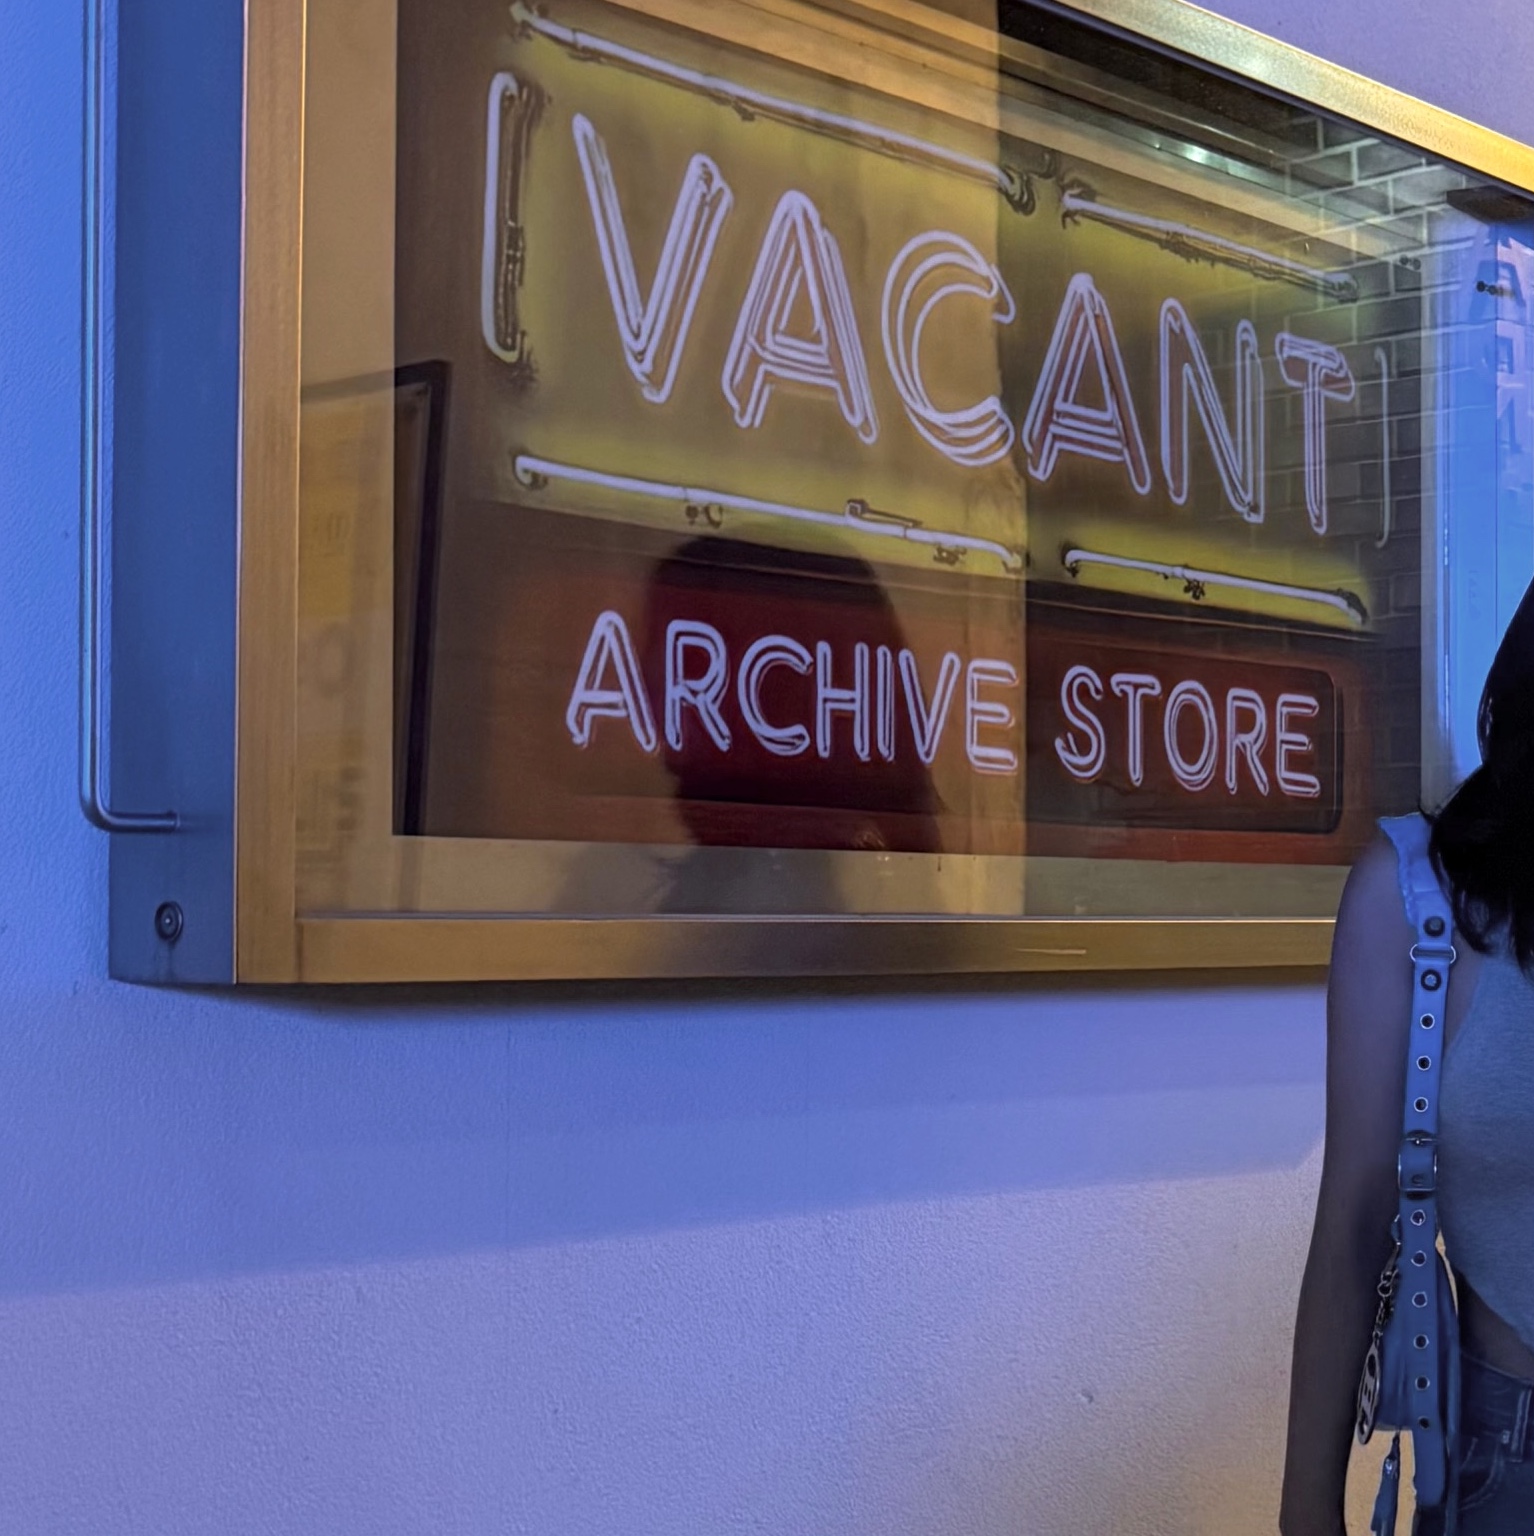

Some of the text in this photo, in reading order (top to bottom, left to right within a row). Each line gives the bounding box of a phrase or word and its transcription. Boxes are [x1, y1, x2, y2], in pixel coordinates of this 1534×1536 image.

[572, 113, 1355, 535] VACANT
[566, 610, 1321, 796] ARCHIVE STORE
